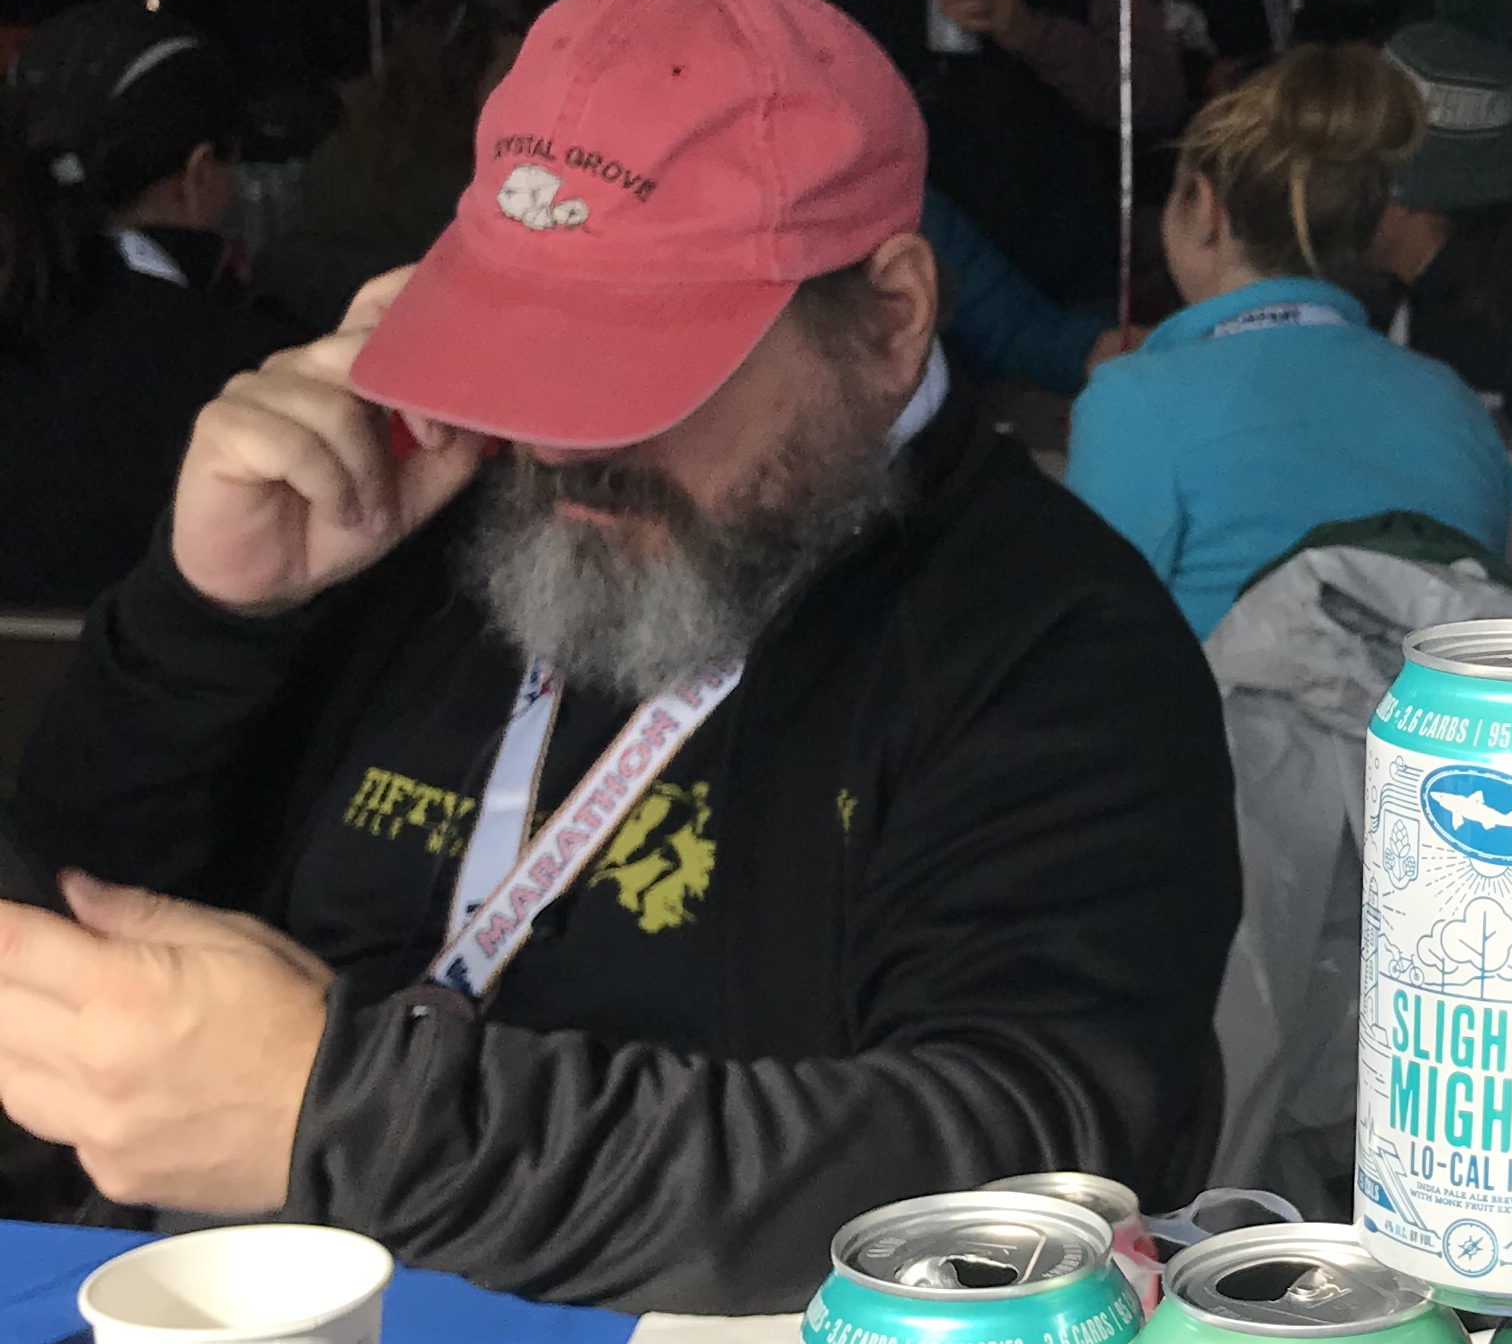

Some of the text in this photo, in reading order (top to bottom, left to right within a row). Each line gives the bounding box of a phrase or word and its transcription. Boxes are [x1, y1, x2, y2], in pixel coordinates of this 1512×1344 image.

[1418, 710, 1470, 744] CARBS
[1487, 722, 1512, 748] 95
[474, 707, 680, 958] MARATHON
[1409, 1141, 1496, 1192] LO-CAL
